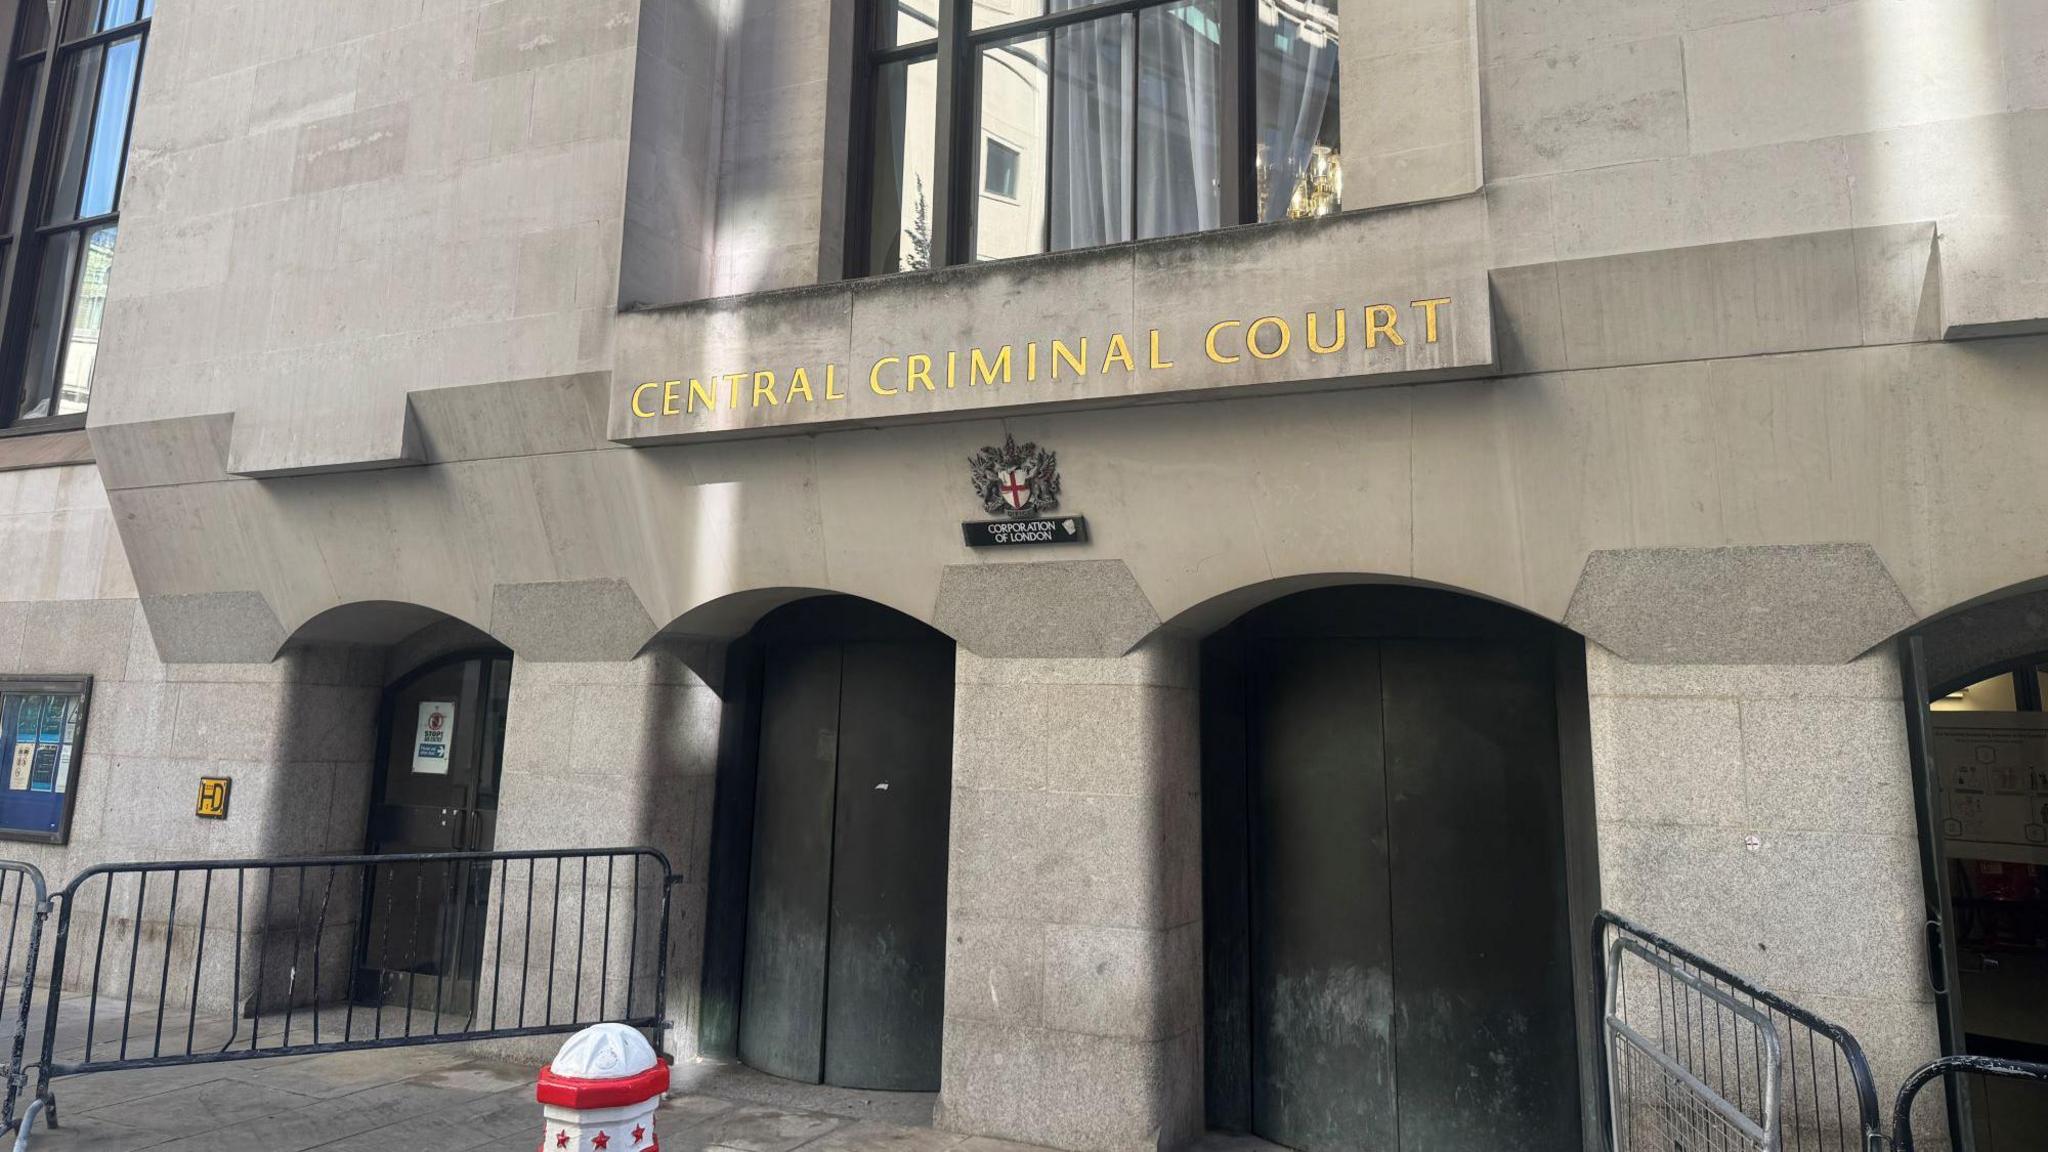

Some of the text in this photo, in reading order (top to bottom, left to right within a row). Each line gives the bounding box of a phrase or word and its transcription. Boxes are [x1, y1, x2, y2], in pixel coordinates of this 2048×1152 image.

[631, 297, 1452, 418] CENTRAL CRIMINAL COURT
[988, 521, 1056, 534] CORPORATION
[995, 531, 1052, 543] OF LONDON
